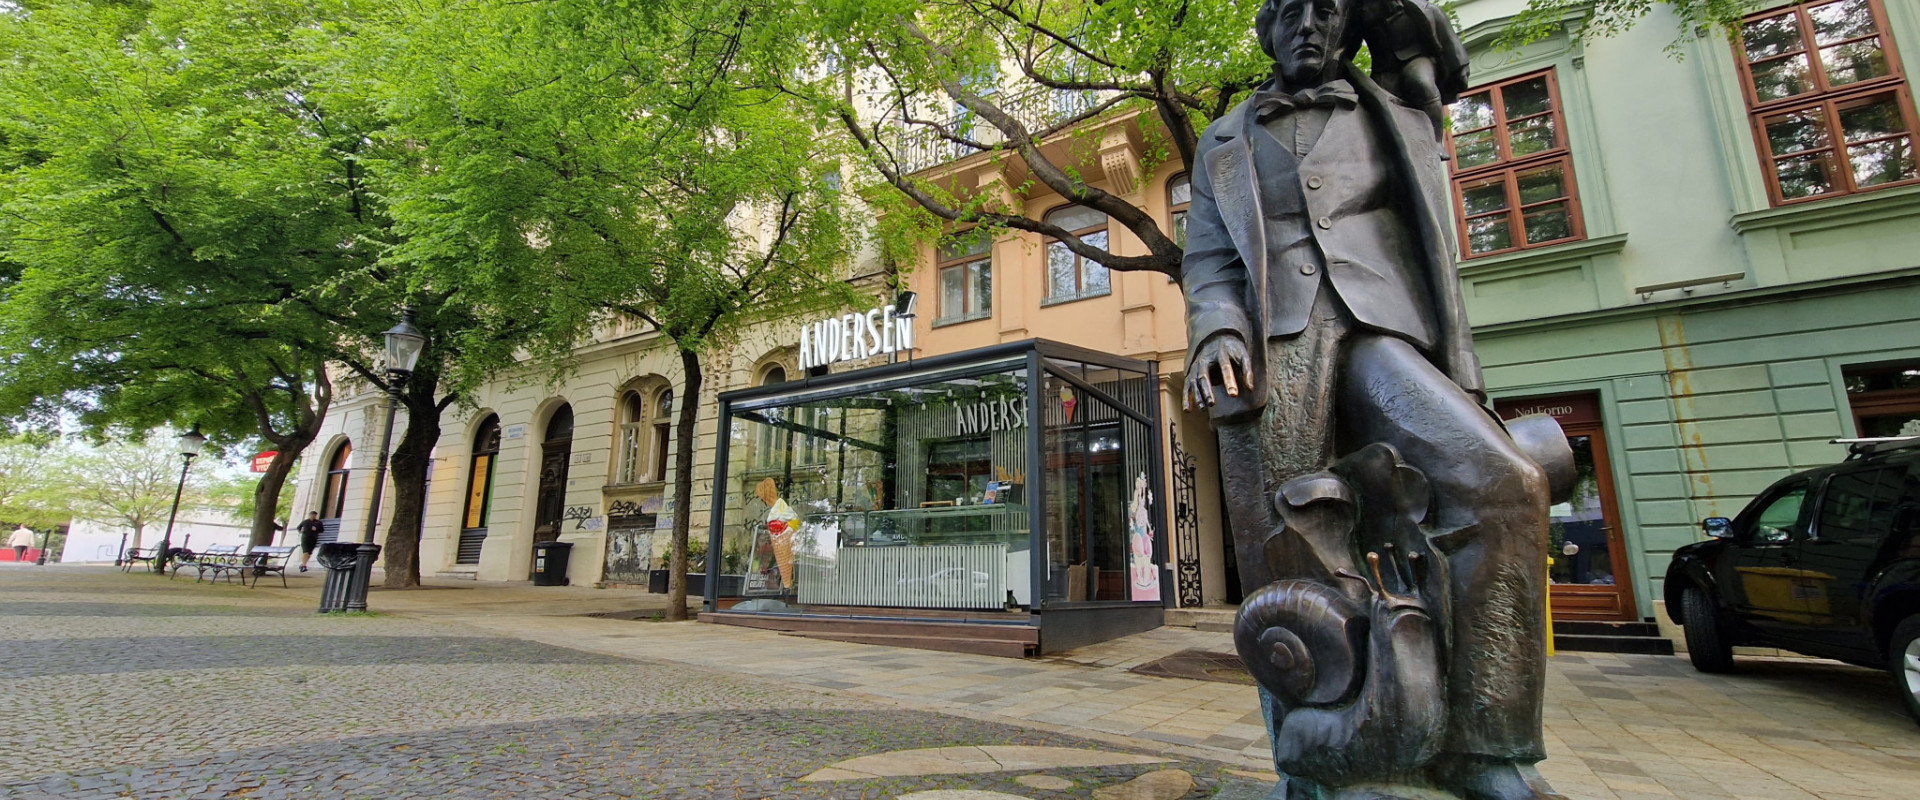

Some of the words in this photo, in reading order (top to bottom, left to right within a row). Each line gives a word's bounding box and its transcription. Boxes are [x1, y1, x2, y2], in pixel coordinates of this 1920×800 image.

[798, 304, 914, 371] ANDERSEN
[957, 396, 1029, 436] ANDERSE
[1536, 405, 1573, 416] Forno
